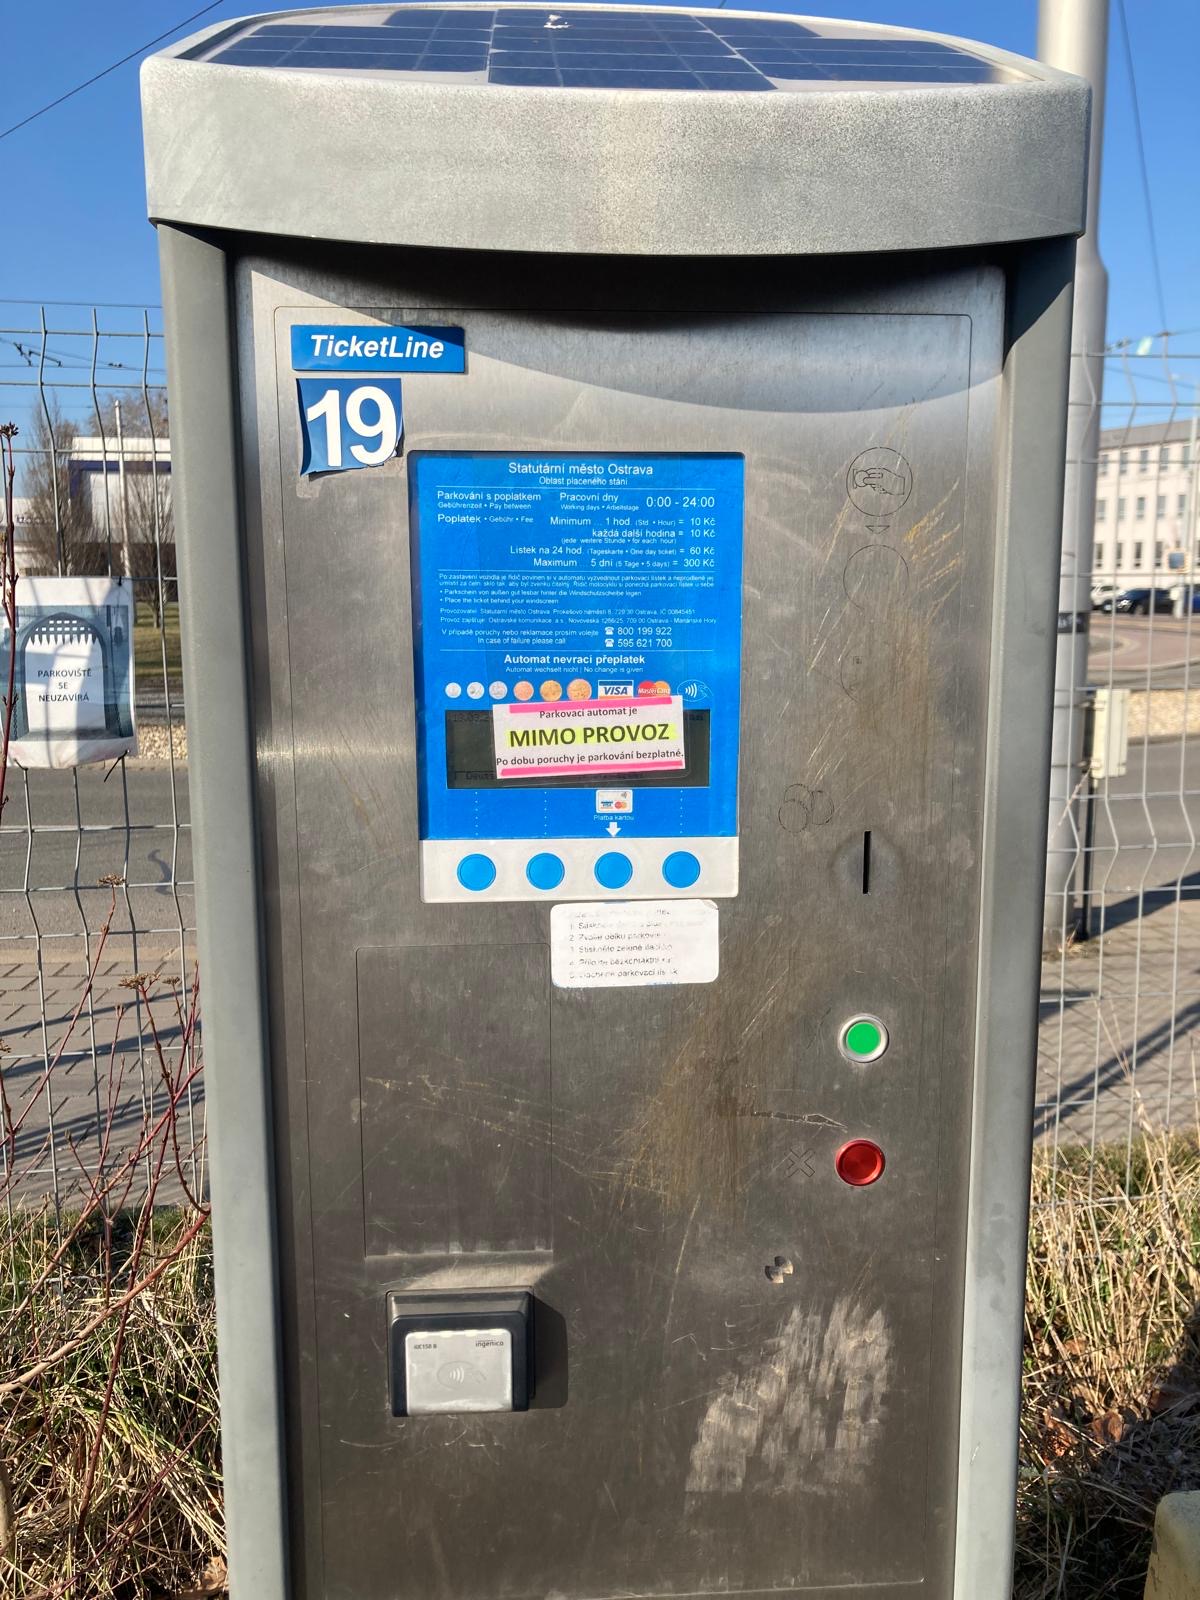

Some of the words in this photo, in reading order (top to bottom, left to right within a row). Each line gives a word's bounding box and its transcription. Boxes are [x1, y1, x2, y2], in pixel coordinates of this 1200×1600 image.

[311, 335, 444, 358] TicketLine
[307, 386, 397, 467] 19
[508, 462, 565, 474] Statutární
[569, 463, 604, 475] město
[608, 464, 653, 475] Ostrava
[539, 476, 565, 485] Oblast
[566, 475, 607, 487] placeného
[609, 477, 628, 486] stání
[437, 490, 483, 500] Parkování
[494, 492, 541, 503] poplatkem
[559, 492, 600, 502] Pracovní
[602, 493, 619, 504] dny
[489, 502, 502, 511] Pay
[503, 502, 532, 510] between
[646, 496, 672, 508] 0:00
[682, 496, 715, 508] 24:00
[560, 504, 585, 512] Working
[585, 504, 600, 512] days
[605, 504, 640, 512] Arbeitstage
[437, 514, 481, 524] Poplatek
[489, 515, 514, 523] Gebühr
[520, 515, 534, 523] Fee
[550, 516, 592, 526] Minimum
[690, 517, 701, 526] 10
[703, 517, 716, 526] Kč
[592, 528, 619, 538] každá
[621, 528, 643, 538] další
[645, 529, 676, 538] hodina
[690, 529, 701, 538] 10
[703, 528, 716, 538] Kč
[510, 546, 536, 555] Lístek
[552, 546, 563, 555] 24
[645, 548, 656, 557] day
[690, 546, 701, 556] 60
[703, 546, 715, 556] Kč
[533, 558, 577, 567] Maximum
[590, 558, 596, 568] 5
[598, 558, 613, 568] dní
[624, 560, 640, 569] Tage
[683, 558, 701, 568] 300
[702, 559, 715, 568] Kč
[441, 628, 447, 636] V
[448, 628, 474, 637] případě
[474, 629, 501, 637] poruchy
[519, 629, 554, 637] reklamace
[554, 629, 577, 638] prosím
[578, 630, 599, 638] volejte
[617, 626, 634, 636] 800
[637, 627, 653, 636] 199
[655, 627, 672, 636] 922
[502, 637, 510, 645] of
[510, 637, 531, 645] failure
[531, 638, 553, 647] please
[617, 638, 634, 648] 595
[636, 639, 653, 648] 621
[655, 638, 673, 648] 700
[504, 654, 551, 664] Automat
[553, 654, 593, 664] nevrací
[595, 654, 646, 666] přeplatek
[37, 668, 92, 679] PARKOVIŠTĚ
[594, 666, 618, 674] change
[58, 681, 68, 690] SE
[604, 687, 628, 695] VISA
[38, 693, 90, 703] NEUZAVÍRÁ
[539, 709, 585, 719] Parkovací
[587, 708, 627, 717] automat
[628, 707, 638, 717] je
[510, 727, 576, 748] MIMO
[583, 723, 670, 744] PROVOZ
[496, 757, 509, 766] Po
[511, 756, 535, 765] dobu
[537, 755, 575, 766] poruchy
[577, 754, 586, 764] je
[588, 751, 634, 764] parkování
[636, 749, 684, 760] bezplatné.
[475, 1340, 504, 1348] ingenico
